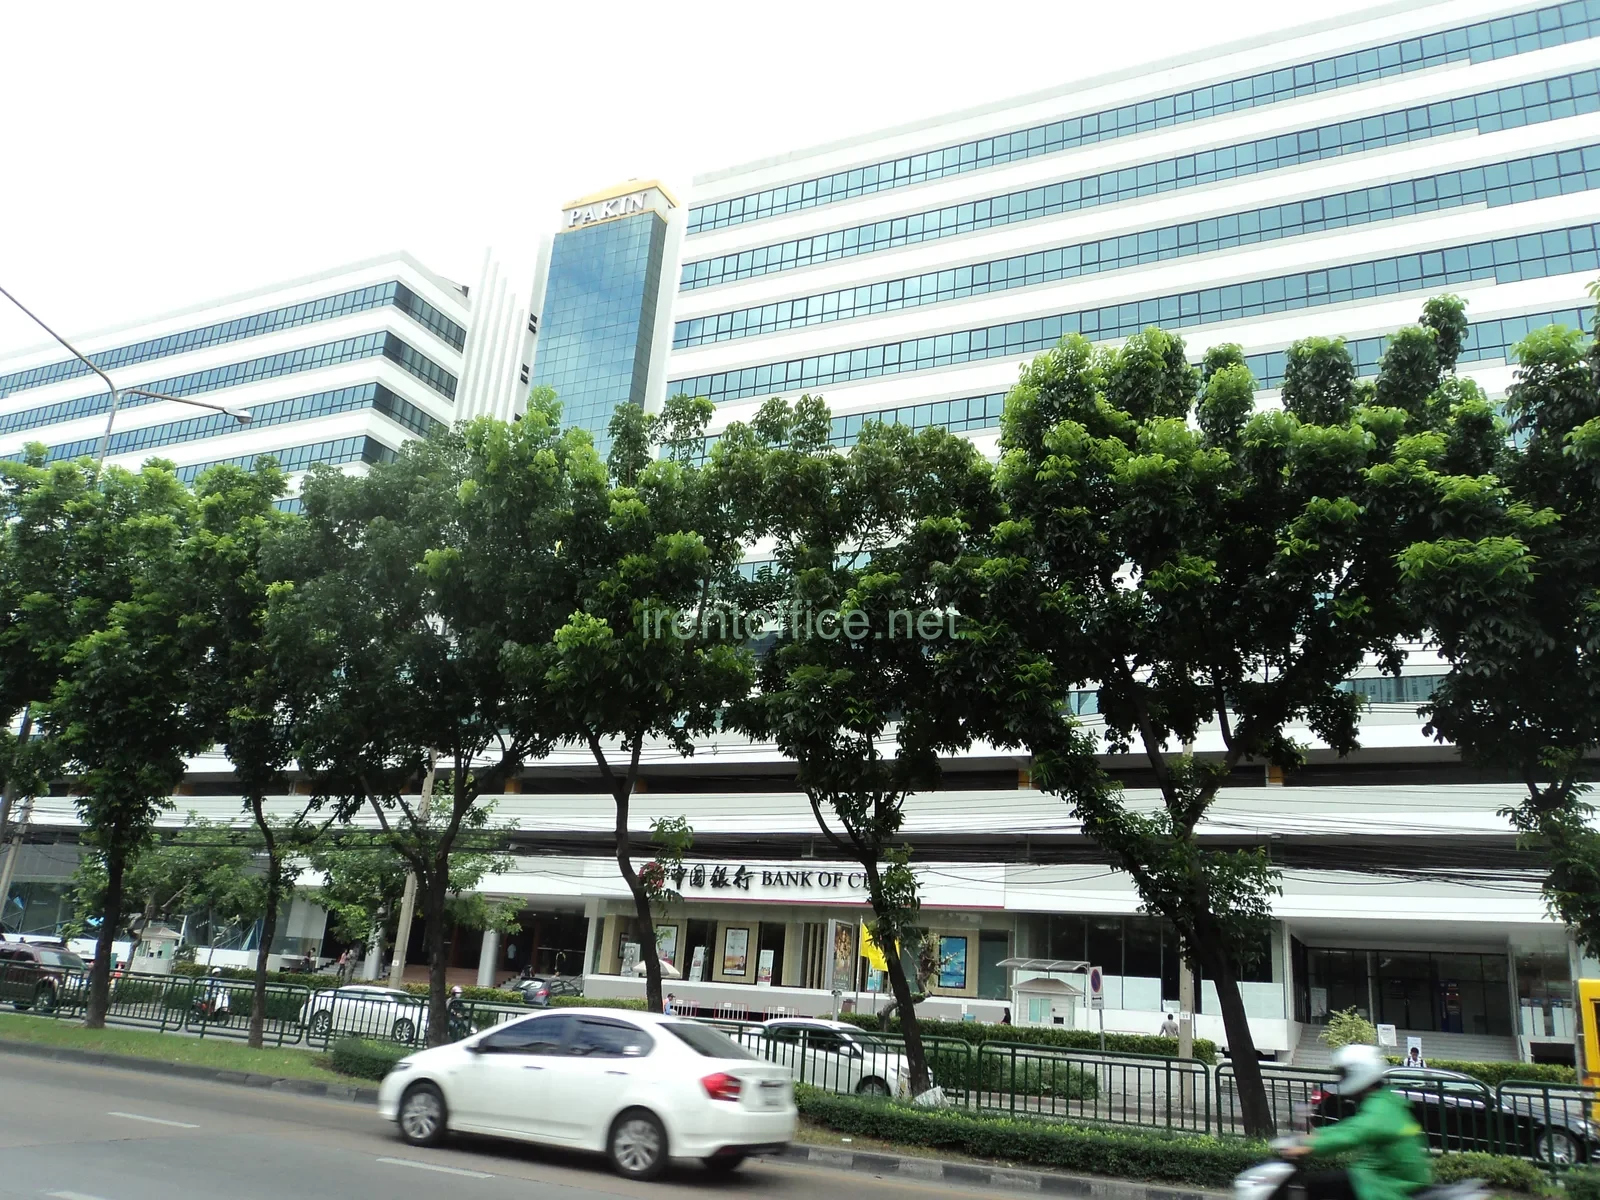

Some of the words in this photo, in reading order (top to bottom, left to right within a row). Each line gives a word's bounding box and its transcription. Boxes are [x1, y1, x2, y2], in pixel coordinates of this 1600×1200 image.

[568, 192, 647, 227] PAKIN
[761, 870, 811, 886] BANK
[818, 873, 841, 888] OF
